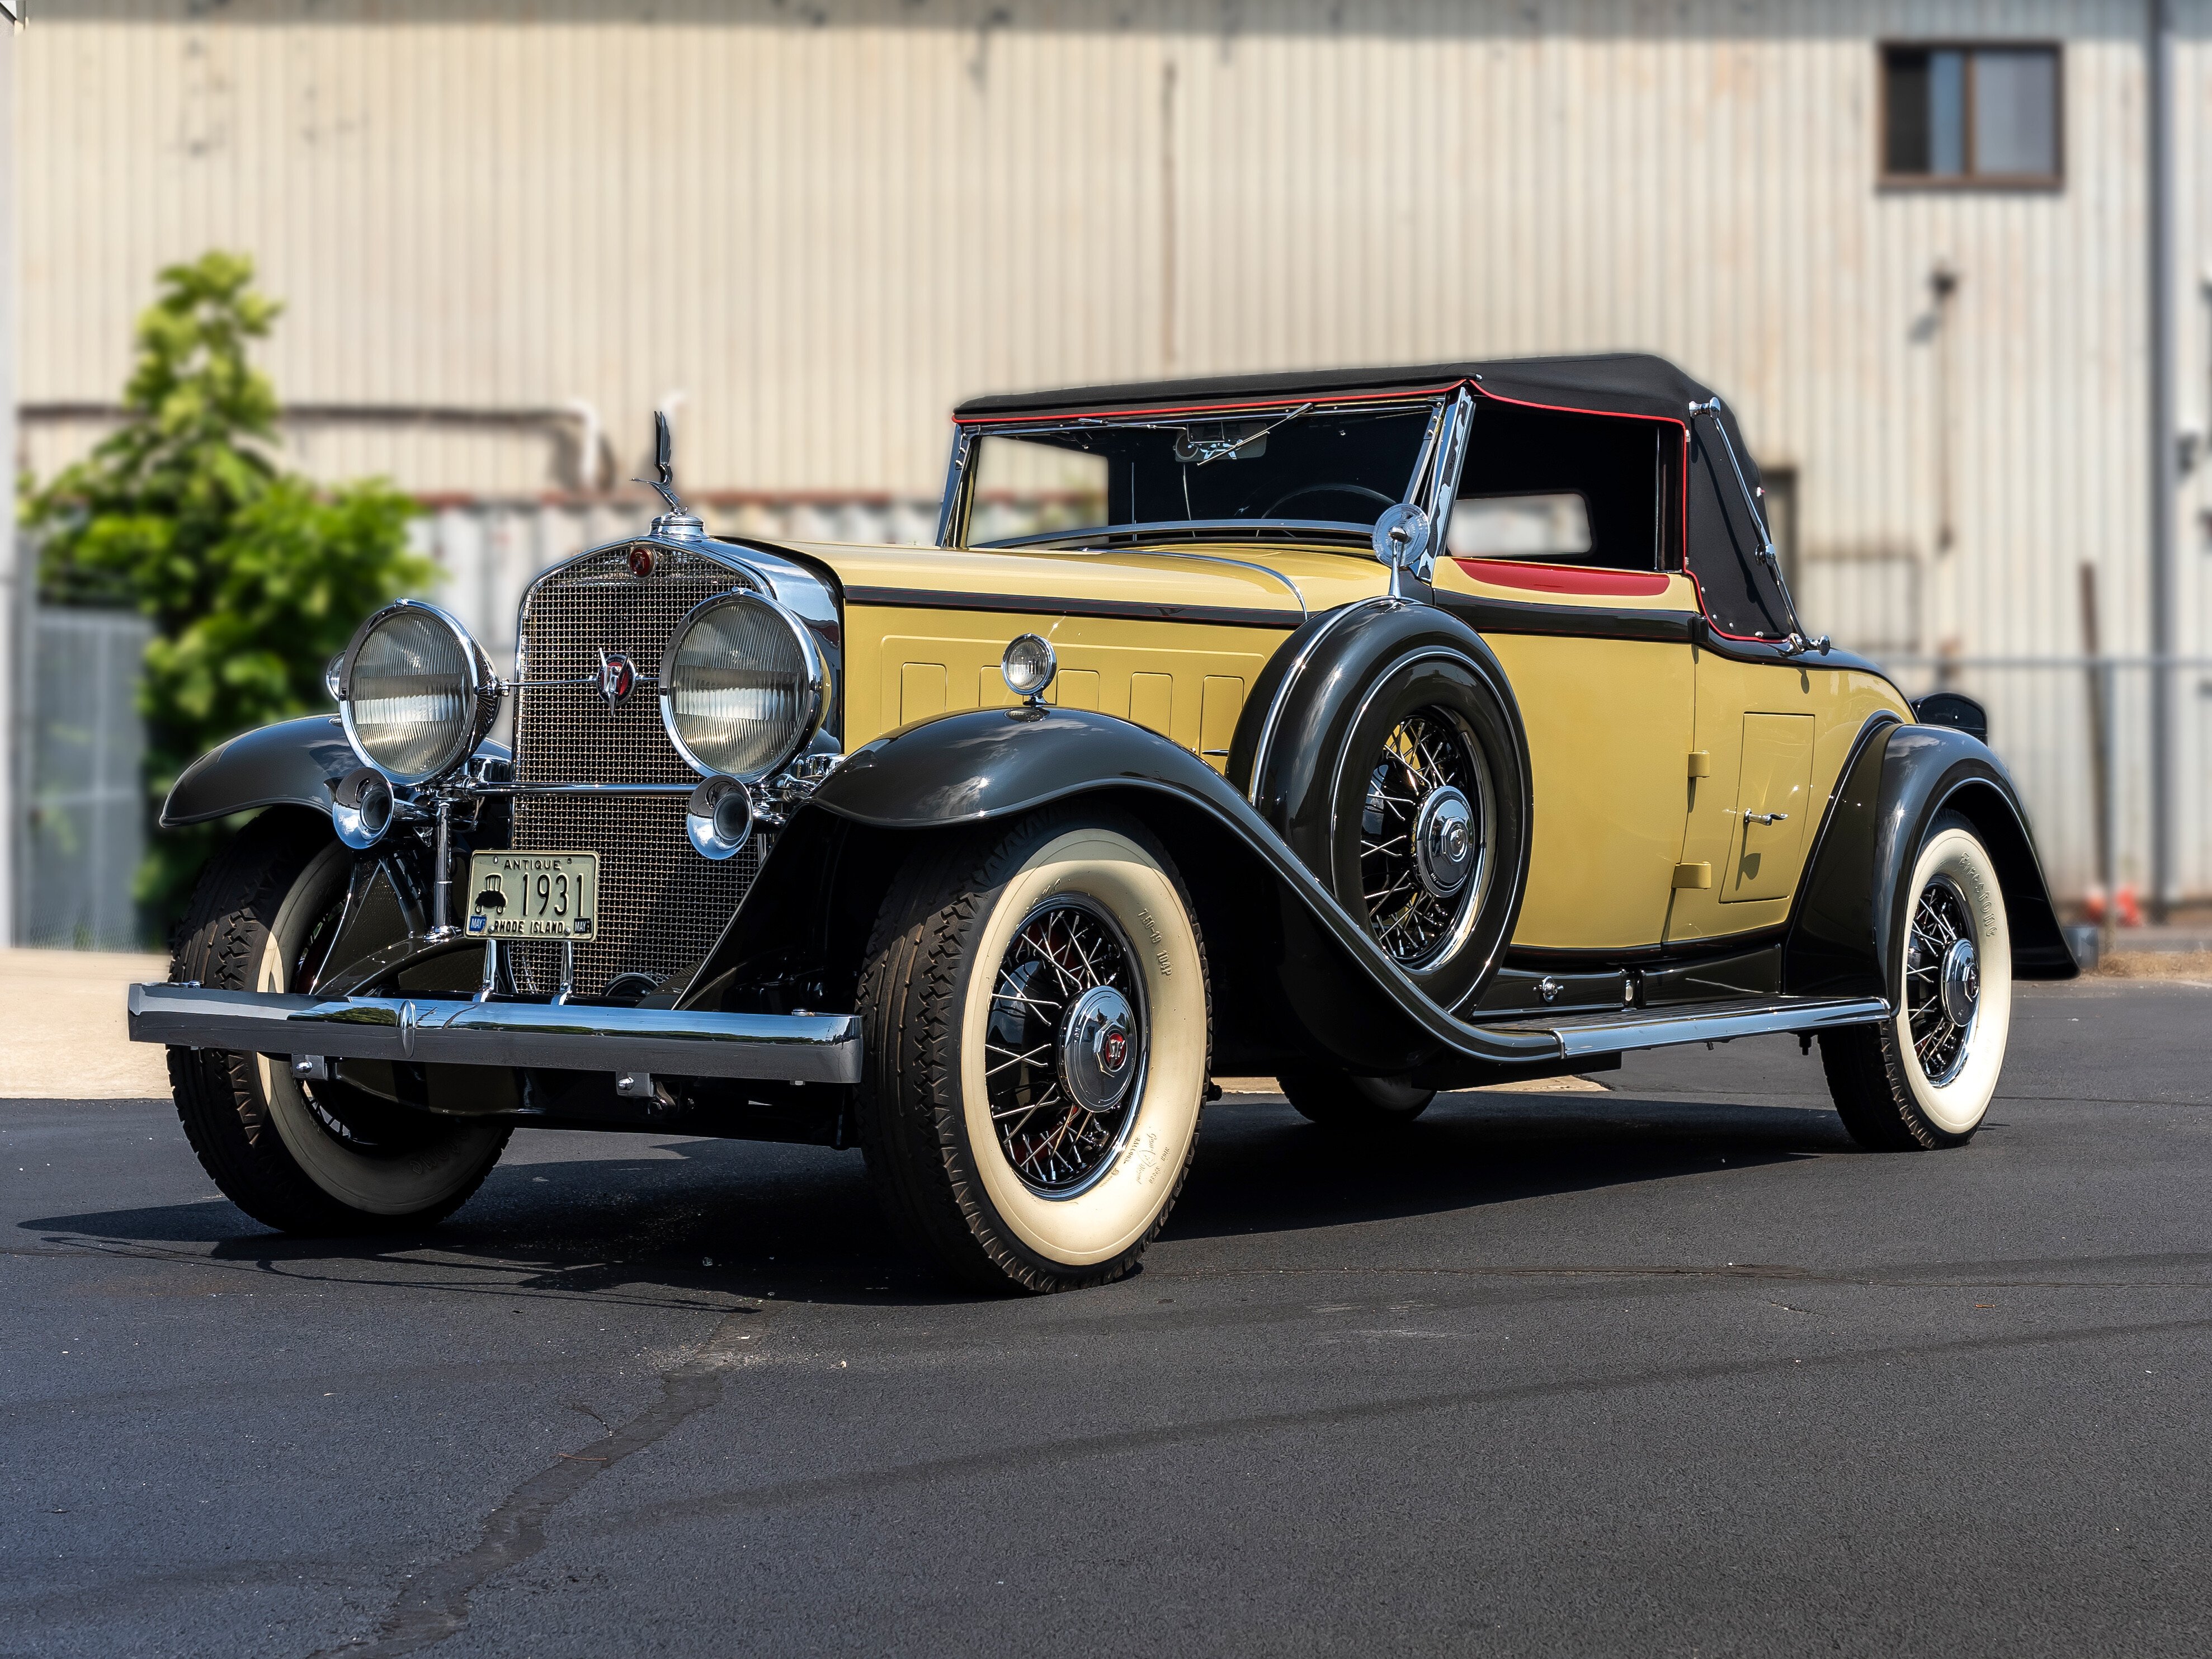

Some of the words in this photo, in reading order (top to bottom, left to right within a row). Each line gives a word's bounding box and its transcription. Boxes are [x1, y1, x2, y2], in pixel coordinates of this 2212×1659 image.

[504, 859, 562, 871] ANTIQUE
[522, 871, 583, 917] 1931
[1959, 851, 1998, 937] Firestone
[470, 918, 483, 929] MAY
[494, 919, 526, 934] RHODE
[530, 920, 565, 934] ISLAND
[575, 921, 587, 931] MAY
[1157, 950, 1173, 975] 104P
